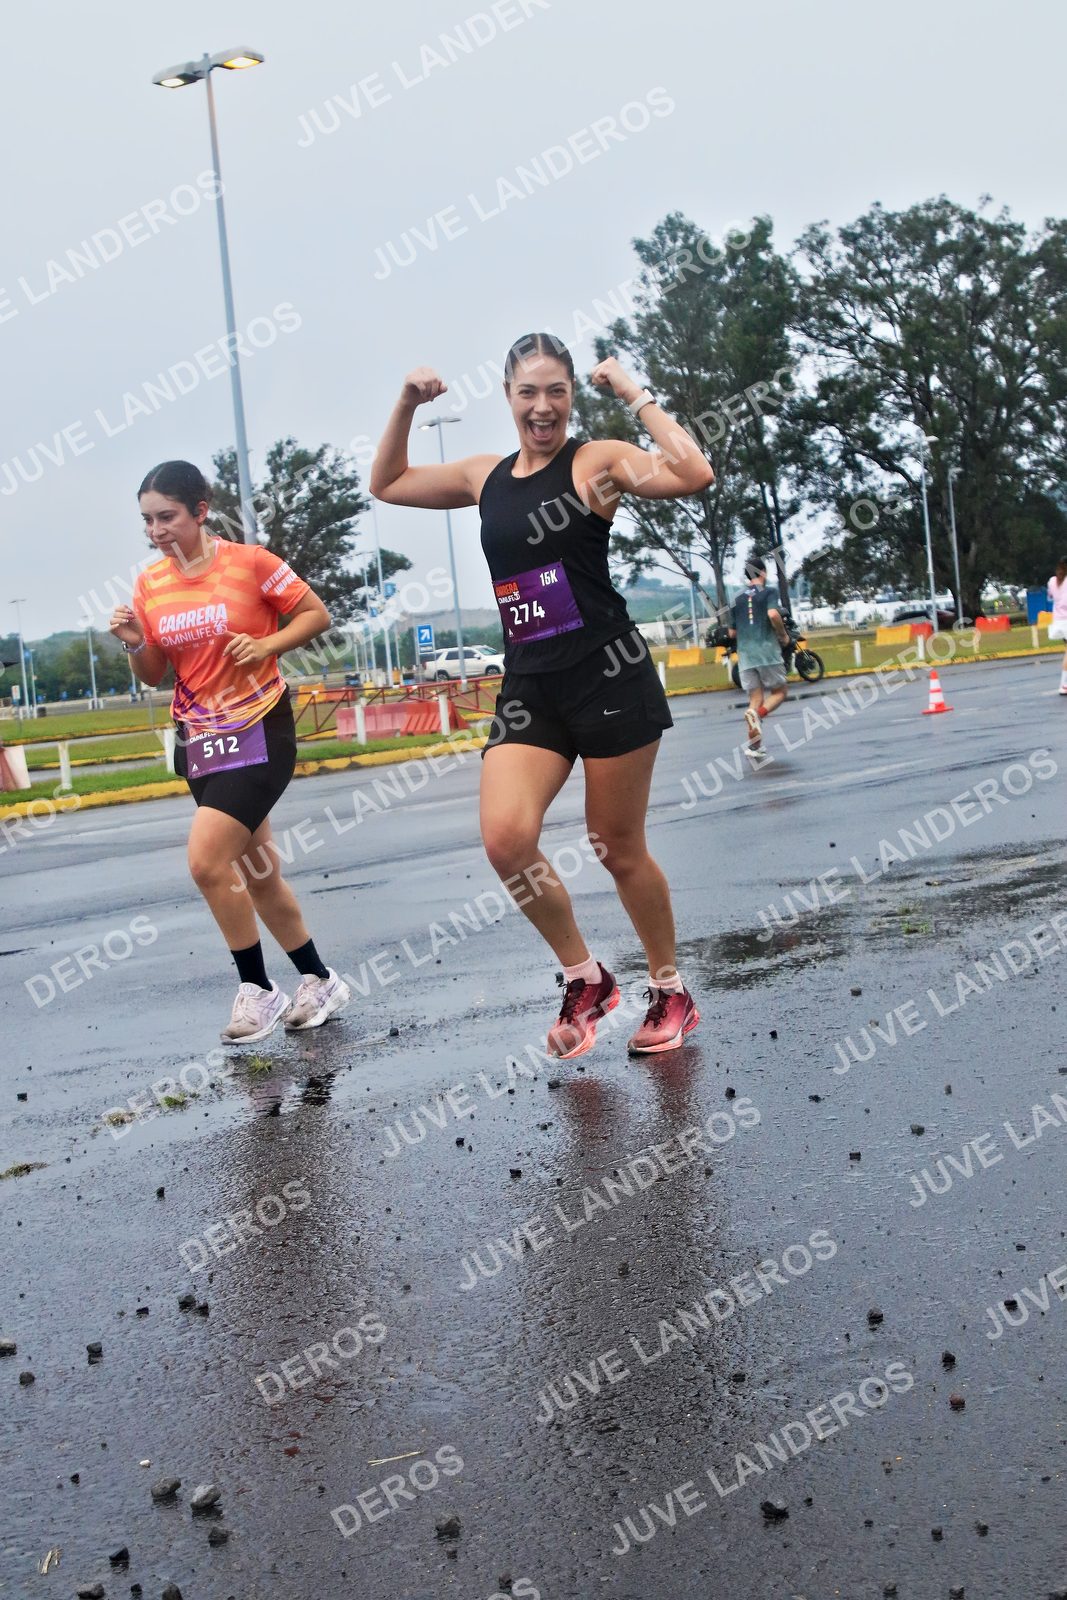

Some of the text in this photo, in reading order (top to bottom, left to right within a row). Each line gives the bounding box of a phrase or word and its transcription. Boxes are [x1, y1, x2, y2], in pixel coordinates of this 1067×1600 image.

[539, 568, 559, 587] 15K
[158, 603, 228, 634] CARRERA
[509, 600, 546, 626] 274
[160, 627, 213, 648] OMNILIFE
[203, 735, 240, 759] 512
